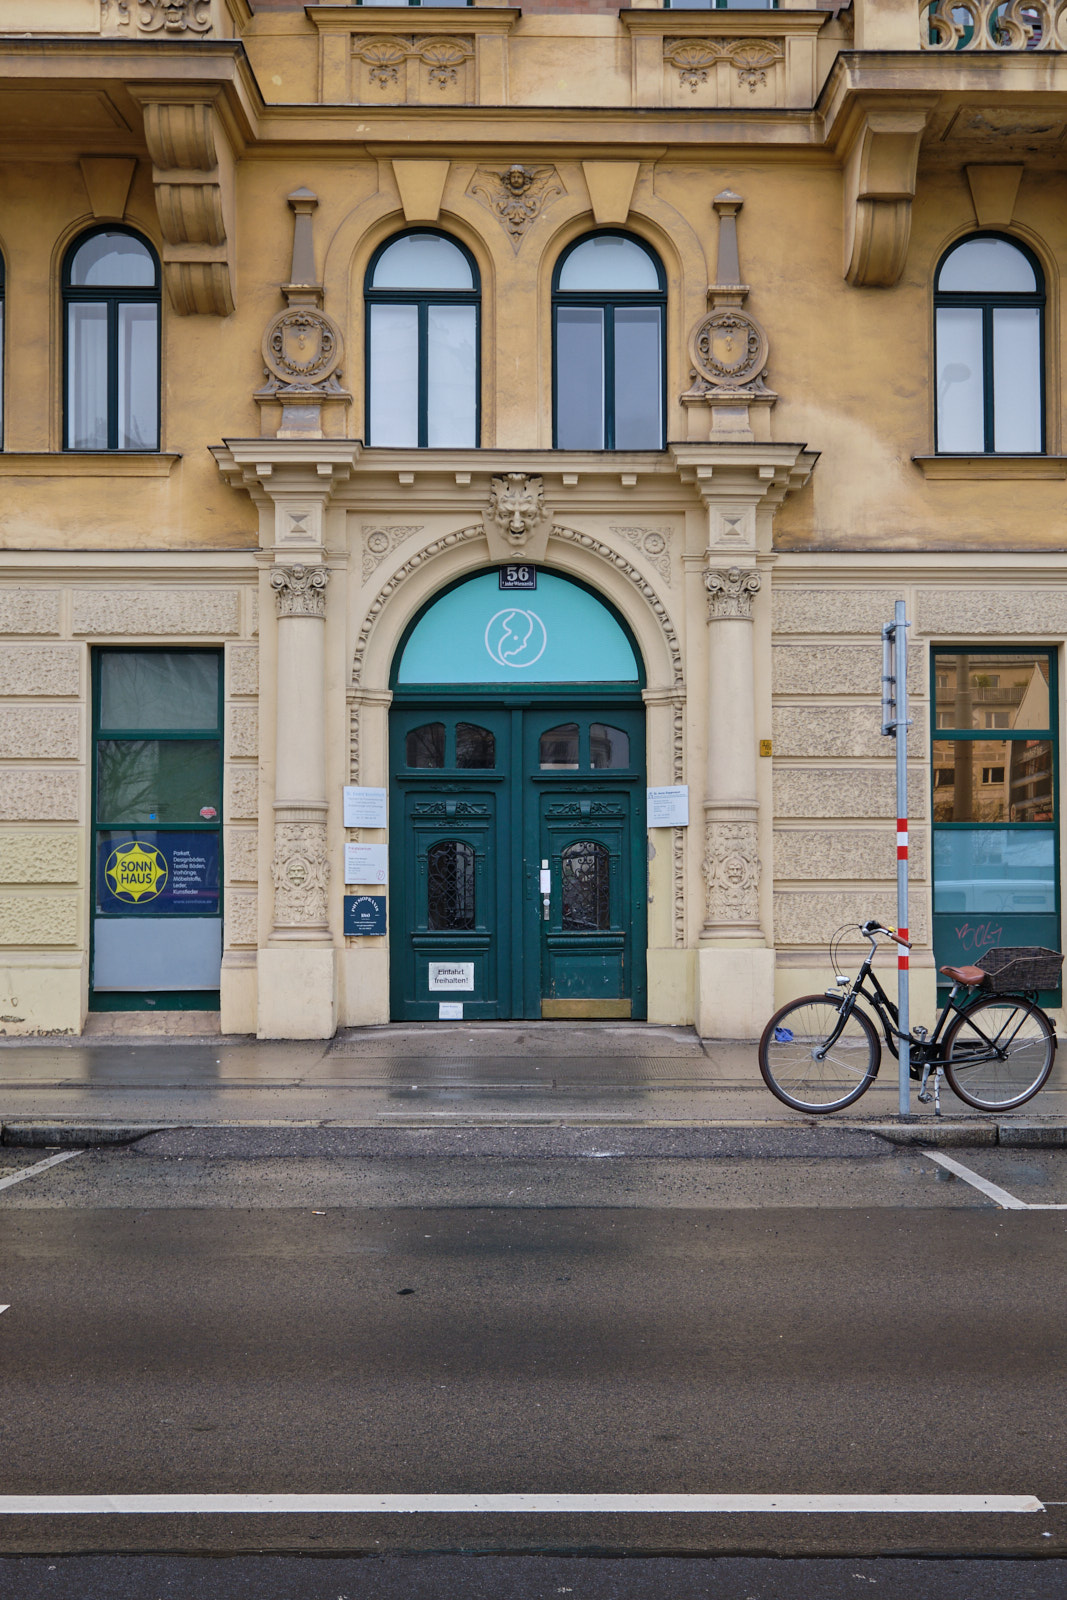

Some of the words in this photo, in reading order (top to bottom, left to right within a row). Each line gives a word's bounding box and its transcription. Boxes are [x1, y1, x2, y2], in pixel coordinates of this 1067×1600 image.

[507, 567, 529, 581] 56
[121, 861, 152, 872] SONN
[121, 873, 152, 884] HAUS
[351, 897, 379, 912] PHYSIOPRAXIS
